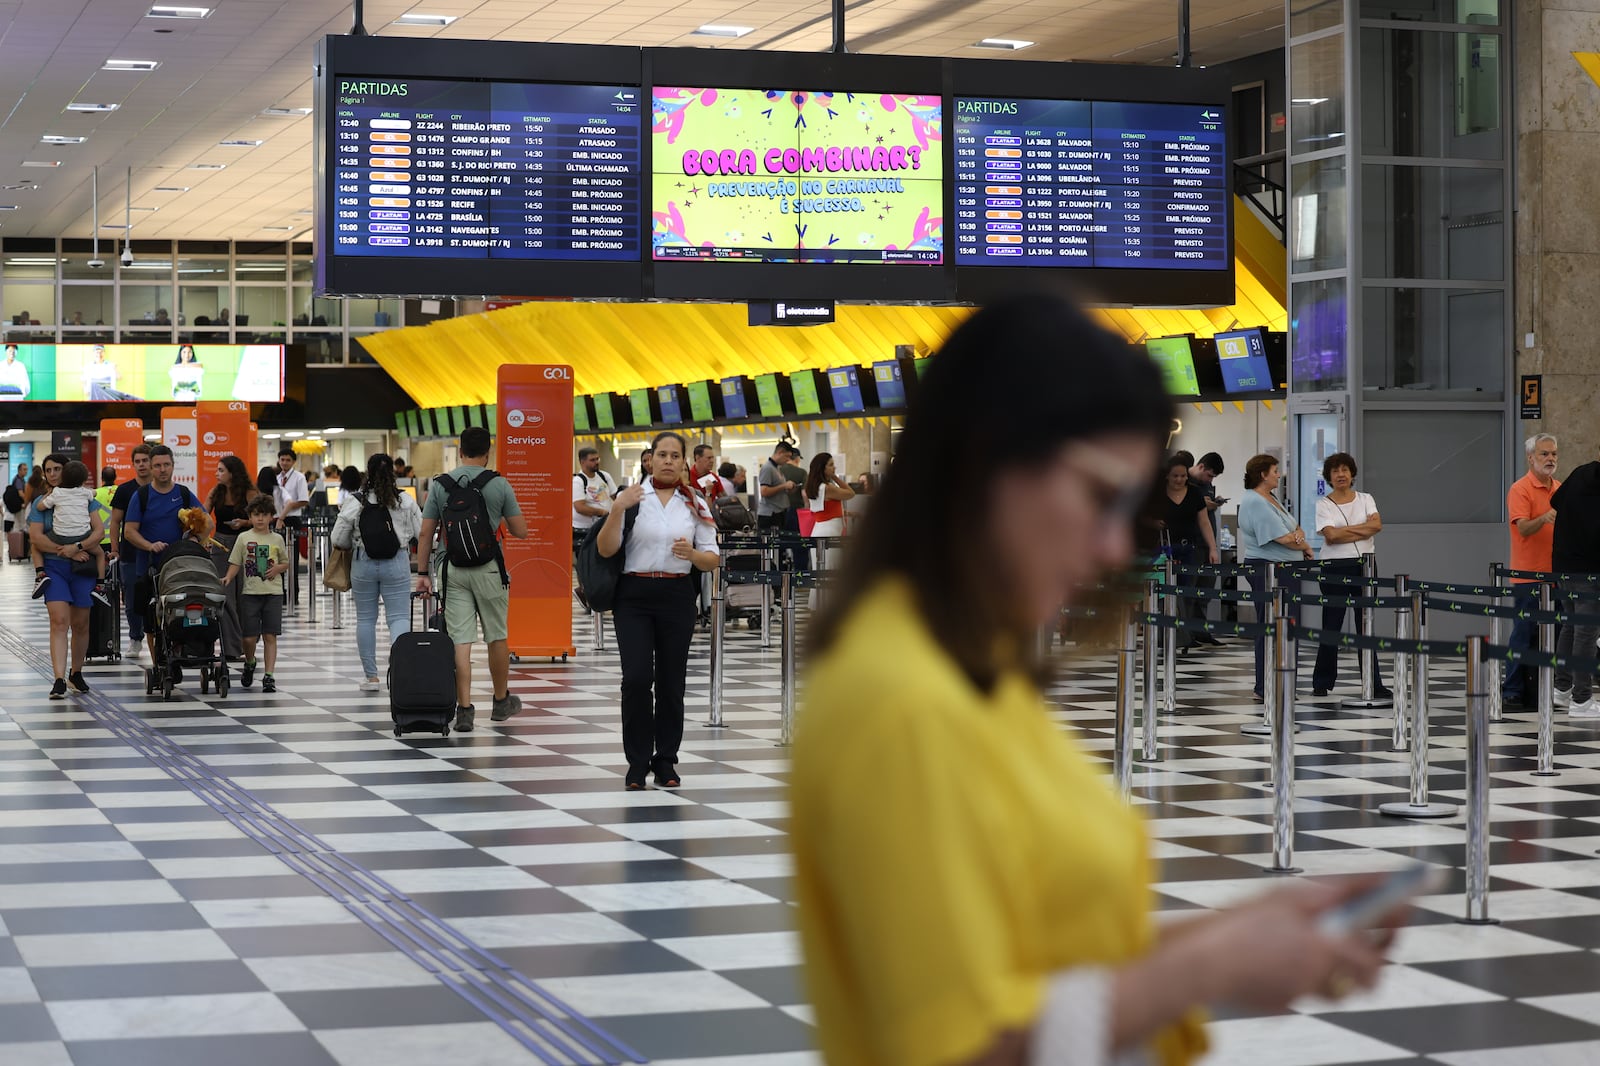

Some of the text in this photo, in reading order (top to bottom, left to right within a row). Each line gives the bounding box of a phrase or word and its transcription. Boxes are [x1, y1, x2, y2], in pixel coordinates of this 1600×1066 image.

[341, 82, 408, 95] PARTIDAS
[958, 102, 1018, 114] PARTIDAS
[452, 122, 485, 131] RIBEIRÃO
[1181, 143, 1210, 151] PRÓXIMO
[682, 146, 922, 176] BORA COMBINAR?
[1181, 154, 1210, 162] PRÓXIMO
[567, 164, 592, 172] ÚLTIMA
[1181, 166, 1210, 174] PRÓXIMO
[1059, 174, 1100, 183] UBERLÂNDIA
[708, 177, 904, 200] PREVENÇÃO NO CARNAVAL
[591, 190, 623, 198] PRÓXIMO
[780, 197, 866, 214] É SUCESSO.
[451, 212, 483, 221] BRASÍLIA
[591, 215, 623, 224] PRÓXIMO
[591, 228, 623, 237] PRÓXIMO
[1060, 236, 1087, 244] GOIÂNIA
[591, 241, 623, 249] PRÓXIMO
[1224, 342, 1241, 354] GOL
[1251, 338, 1260, 350] 51
[544, 368, 570, 380] GOL
[228, 402, 248, 411] GOL
[507, 435, 546, 446] Serviços
